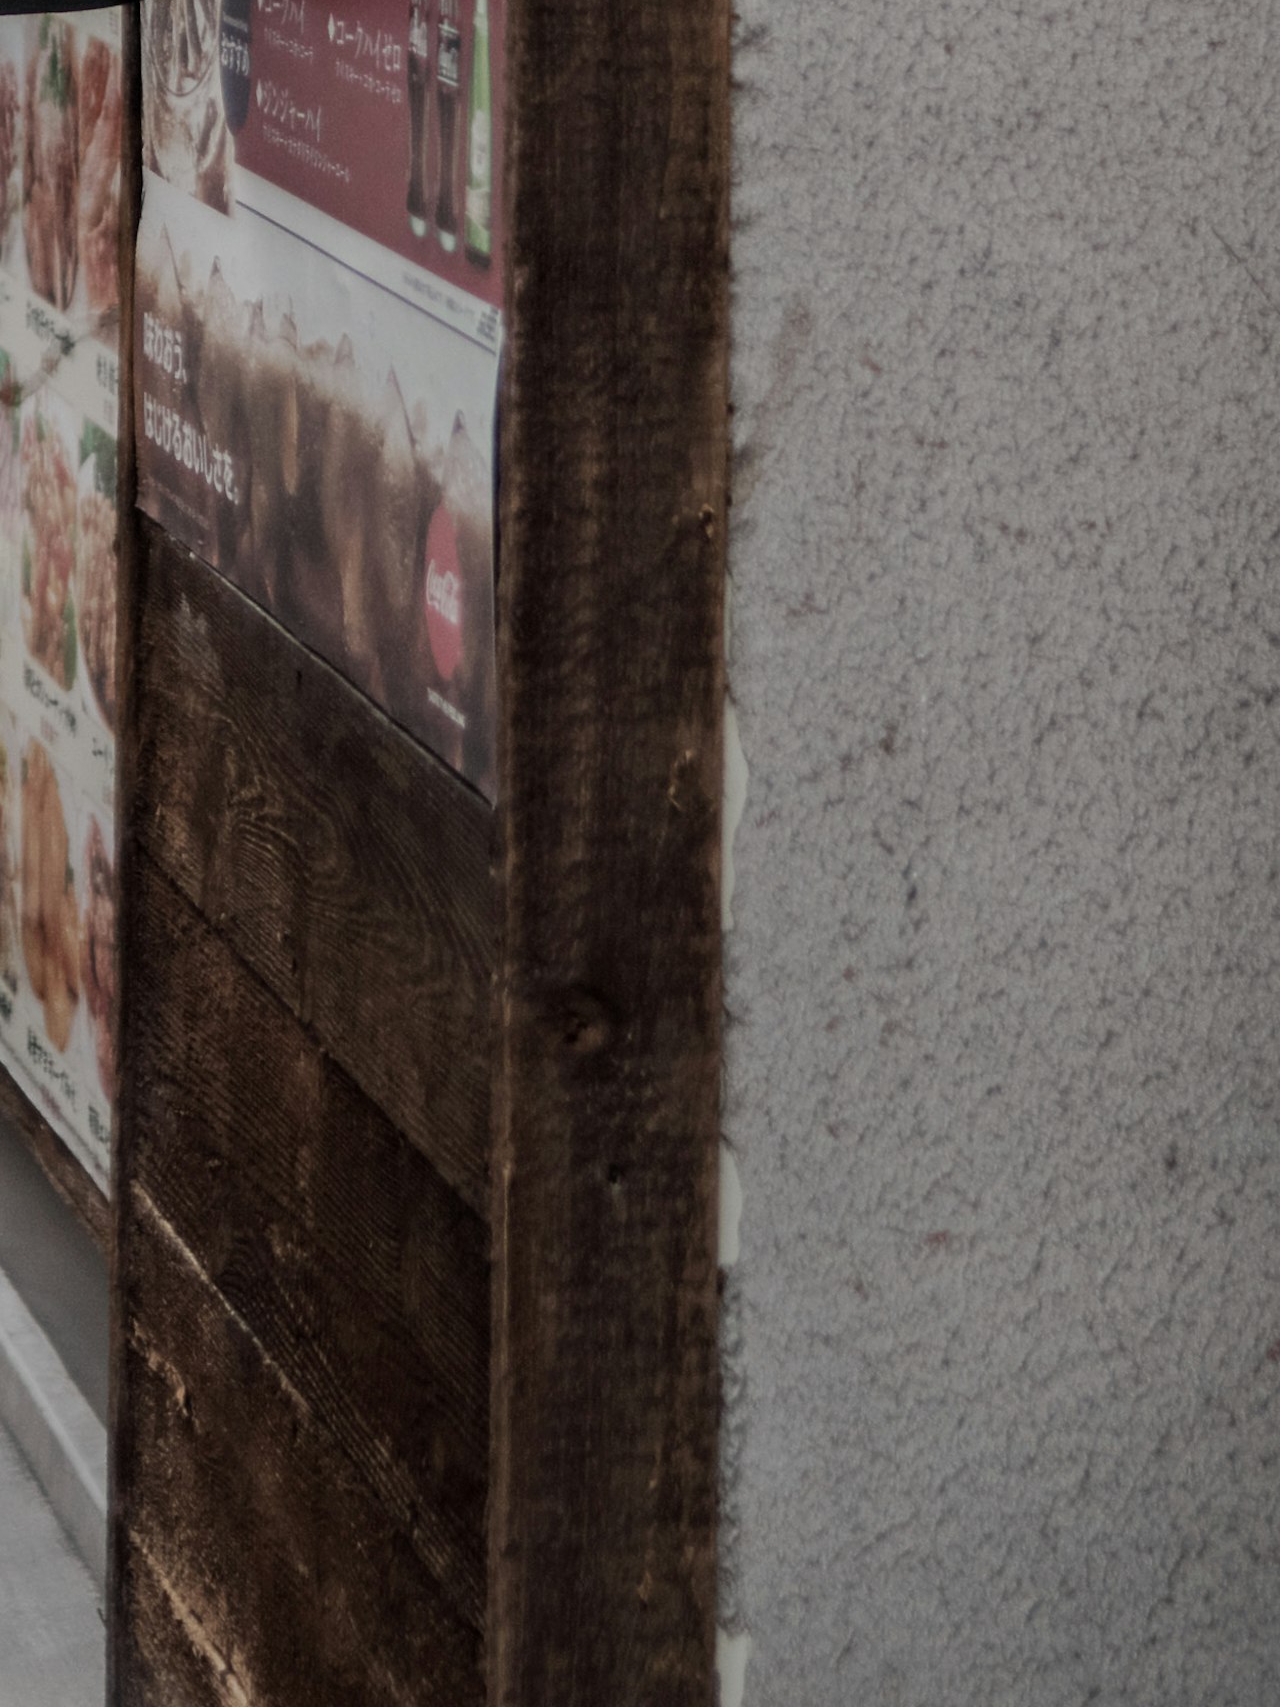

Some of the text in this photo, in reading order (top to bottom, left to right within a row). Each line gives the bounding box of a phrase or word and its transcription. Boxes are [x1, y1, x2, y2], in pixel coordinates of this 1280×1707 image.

[221, 33, 250, 77] おすすめ
[337, 20, 402, 73] コークハイゼロ
[263, 81, 322, 144] ジンジャーハイ
[143, 391, 240, 506] はじけるおいしさを。
